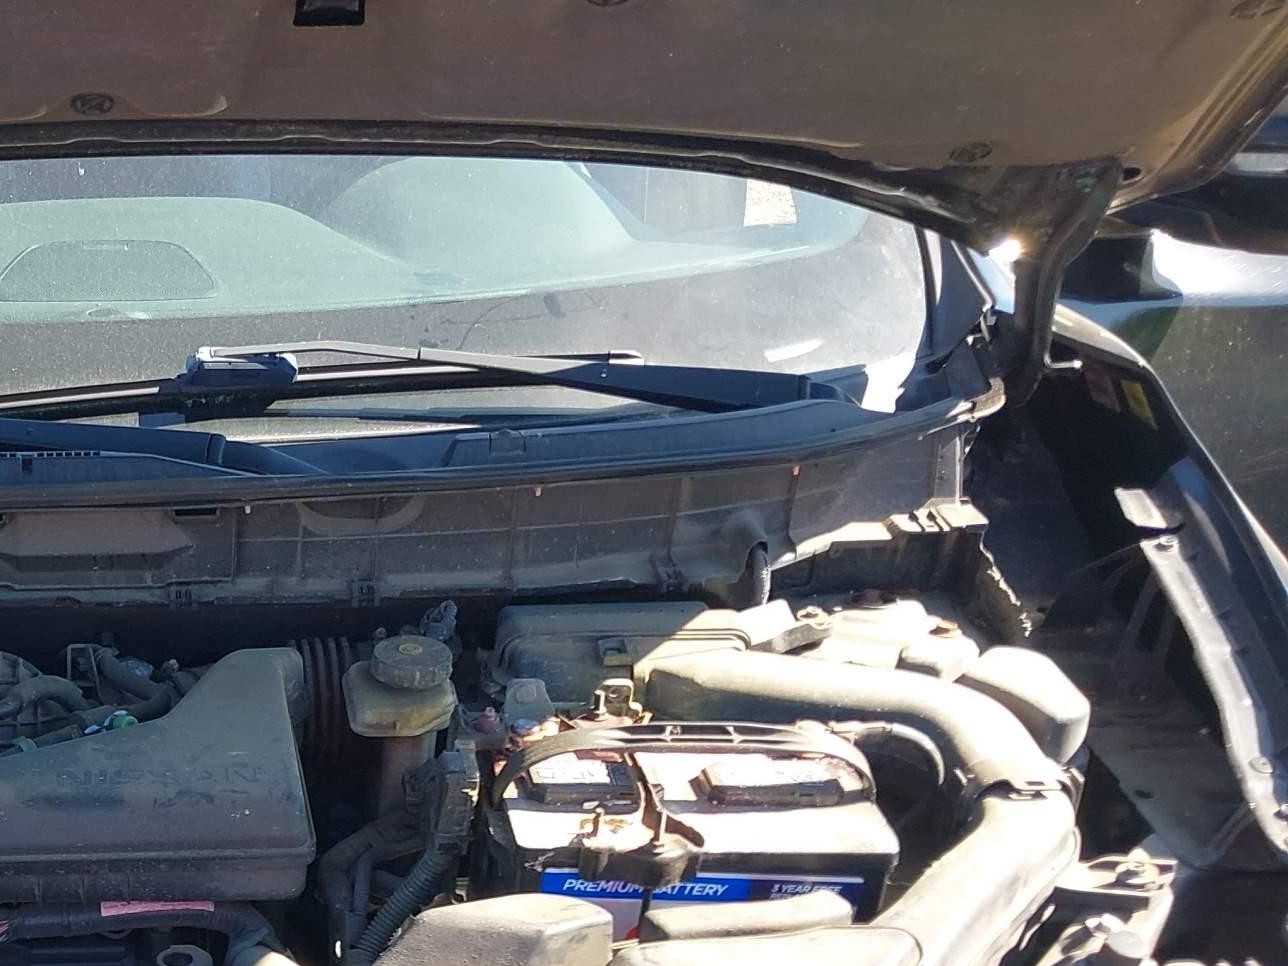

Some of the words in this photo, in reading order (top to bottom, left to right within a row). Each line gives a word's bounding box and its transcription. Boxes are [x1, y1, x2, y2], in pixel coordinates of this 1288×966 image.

[562, 878, 644, 894] PREMIUM
[651, 882, 729, 897] ATTERY
[781, 884, 812, 894] YEAR
